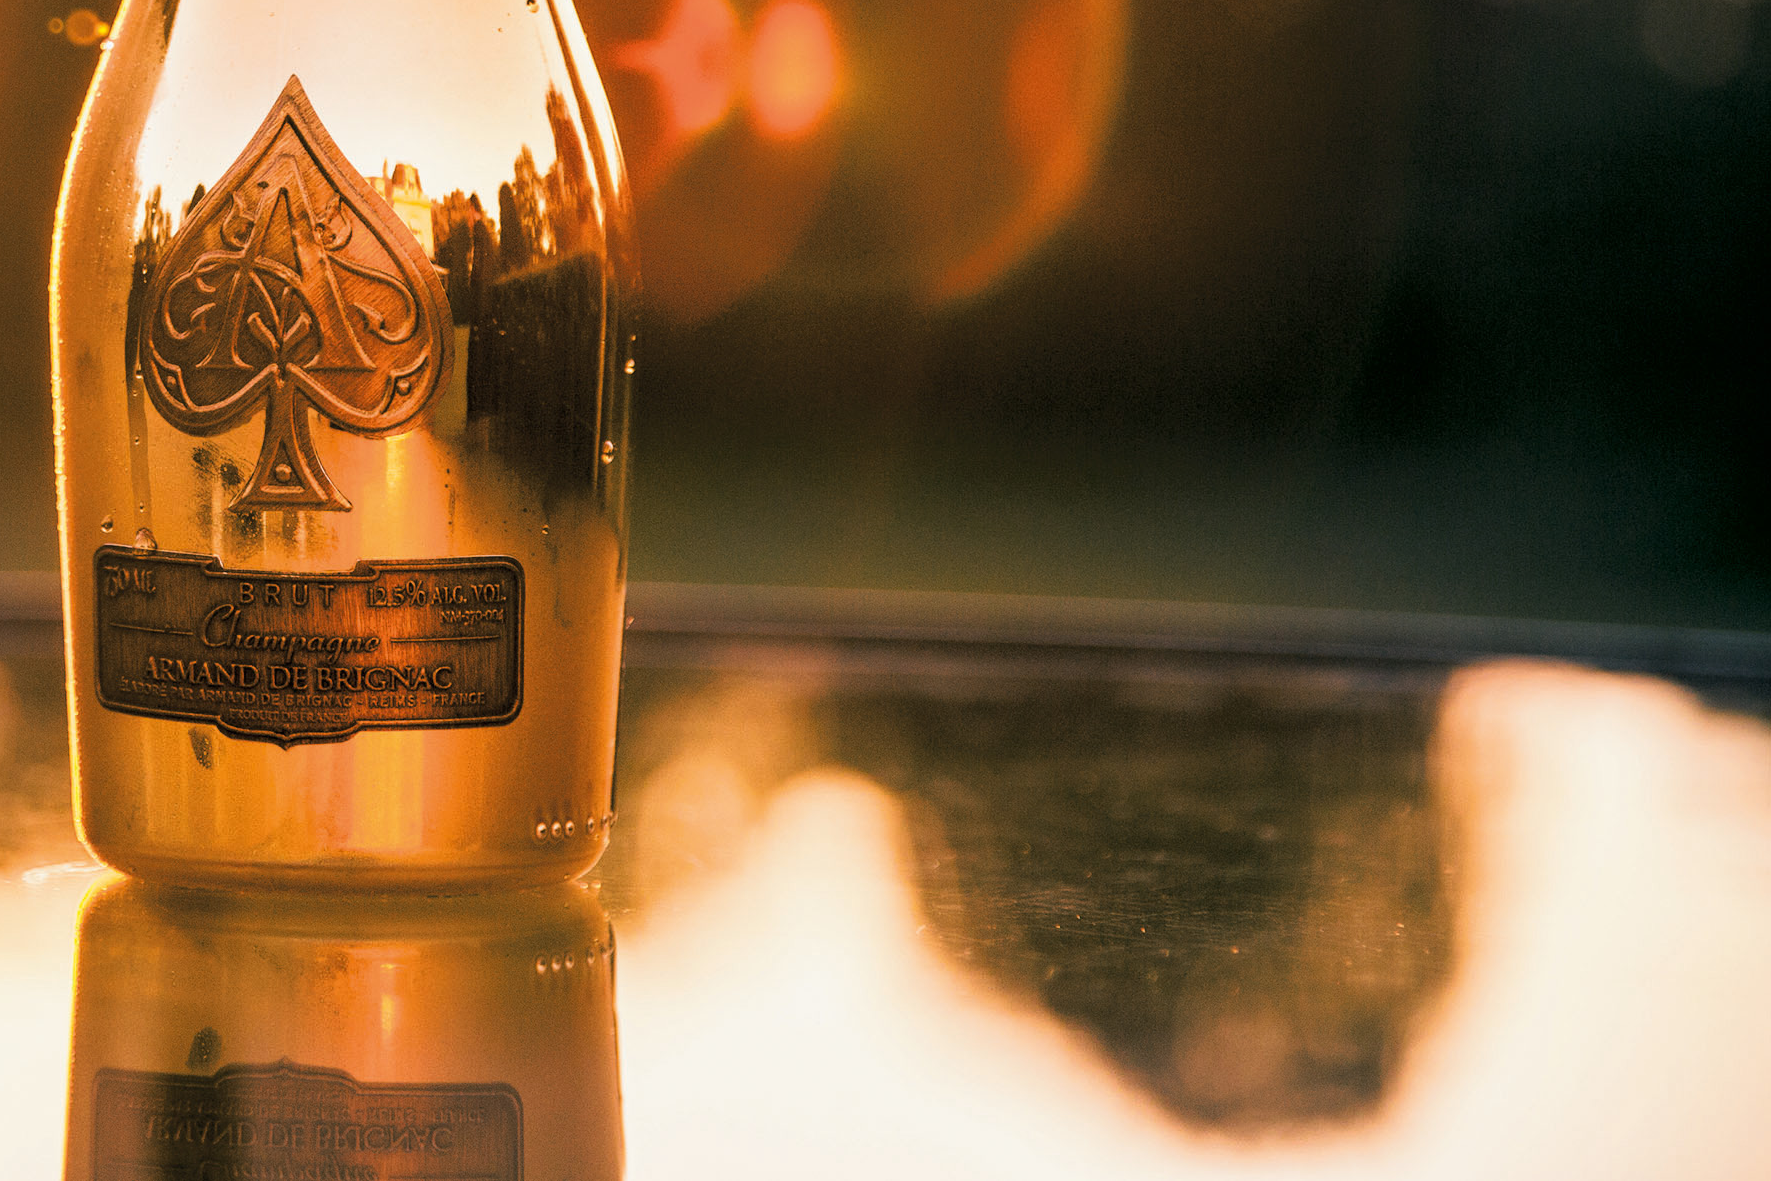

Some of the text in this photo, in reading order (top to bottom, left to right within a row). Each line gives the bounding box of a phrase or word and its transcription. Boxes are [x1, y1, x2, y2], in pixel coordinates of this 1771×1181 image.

[239, 582, 335, 607] BRUT
[369, 579, 427, 607] 12.5%
[470, 583, 507, 603] VOL.
[202, 603, 382, 665] Champagne
[145, 656, 454, 692] ARMAND DE BRIGNAC
[198, 687, 257, 704] ARMAND
[261, 693, 281, 706] DE
[285, 693, 352, 708] BRIGNAC
[369, 694, 418, 709] REIMS
[432, 691, 486, 707] FRANCE
